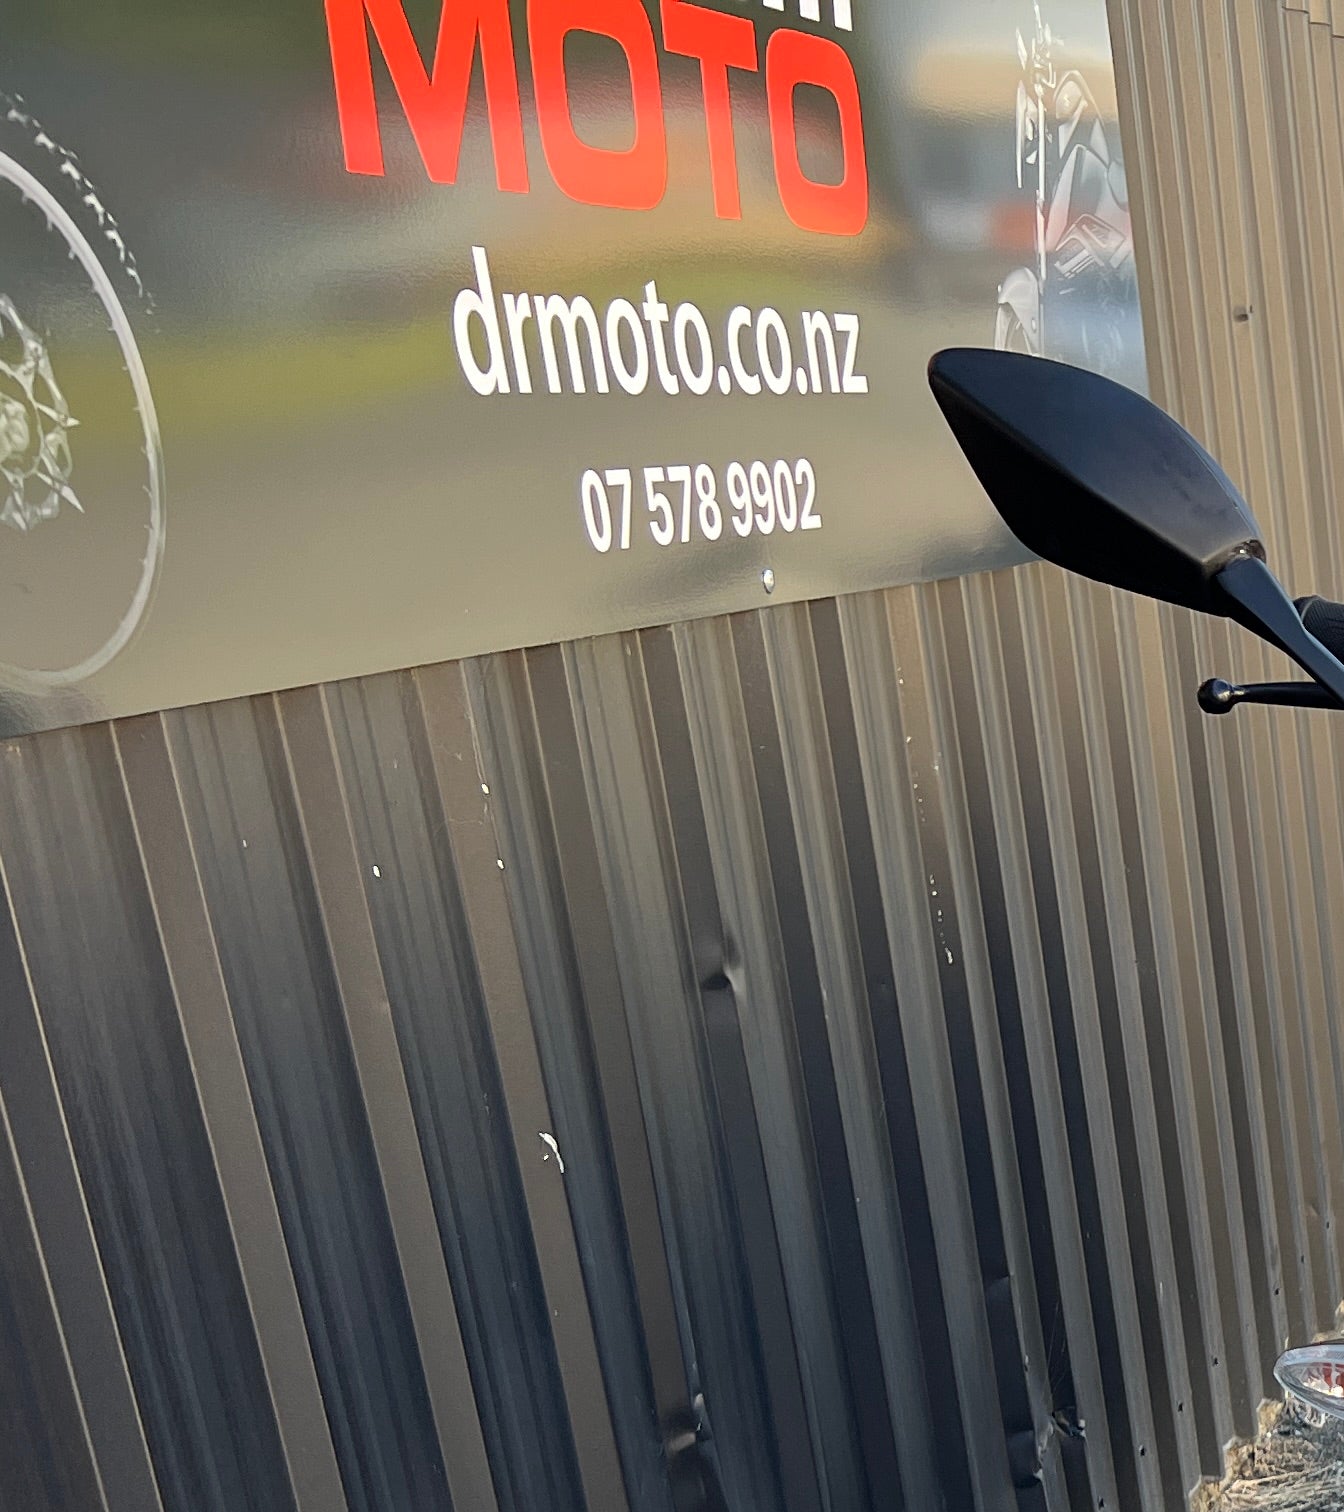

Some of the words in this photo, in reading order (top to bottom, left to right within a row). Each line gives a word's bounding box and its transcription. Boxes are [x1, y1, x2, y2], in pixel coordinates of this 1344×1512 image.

[323, 0, 869, 236] MOTO
[453, 246, 869, 396] drmoto.co.nz
[581, 468, 632, 552] 07
[643, 465, 722, 546] 578
[726, 458, 822, 537] 9902
